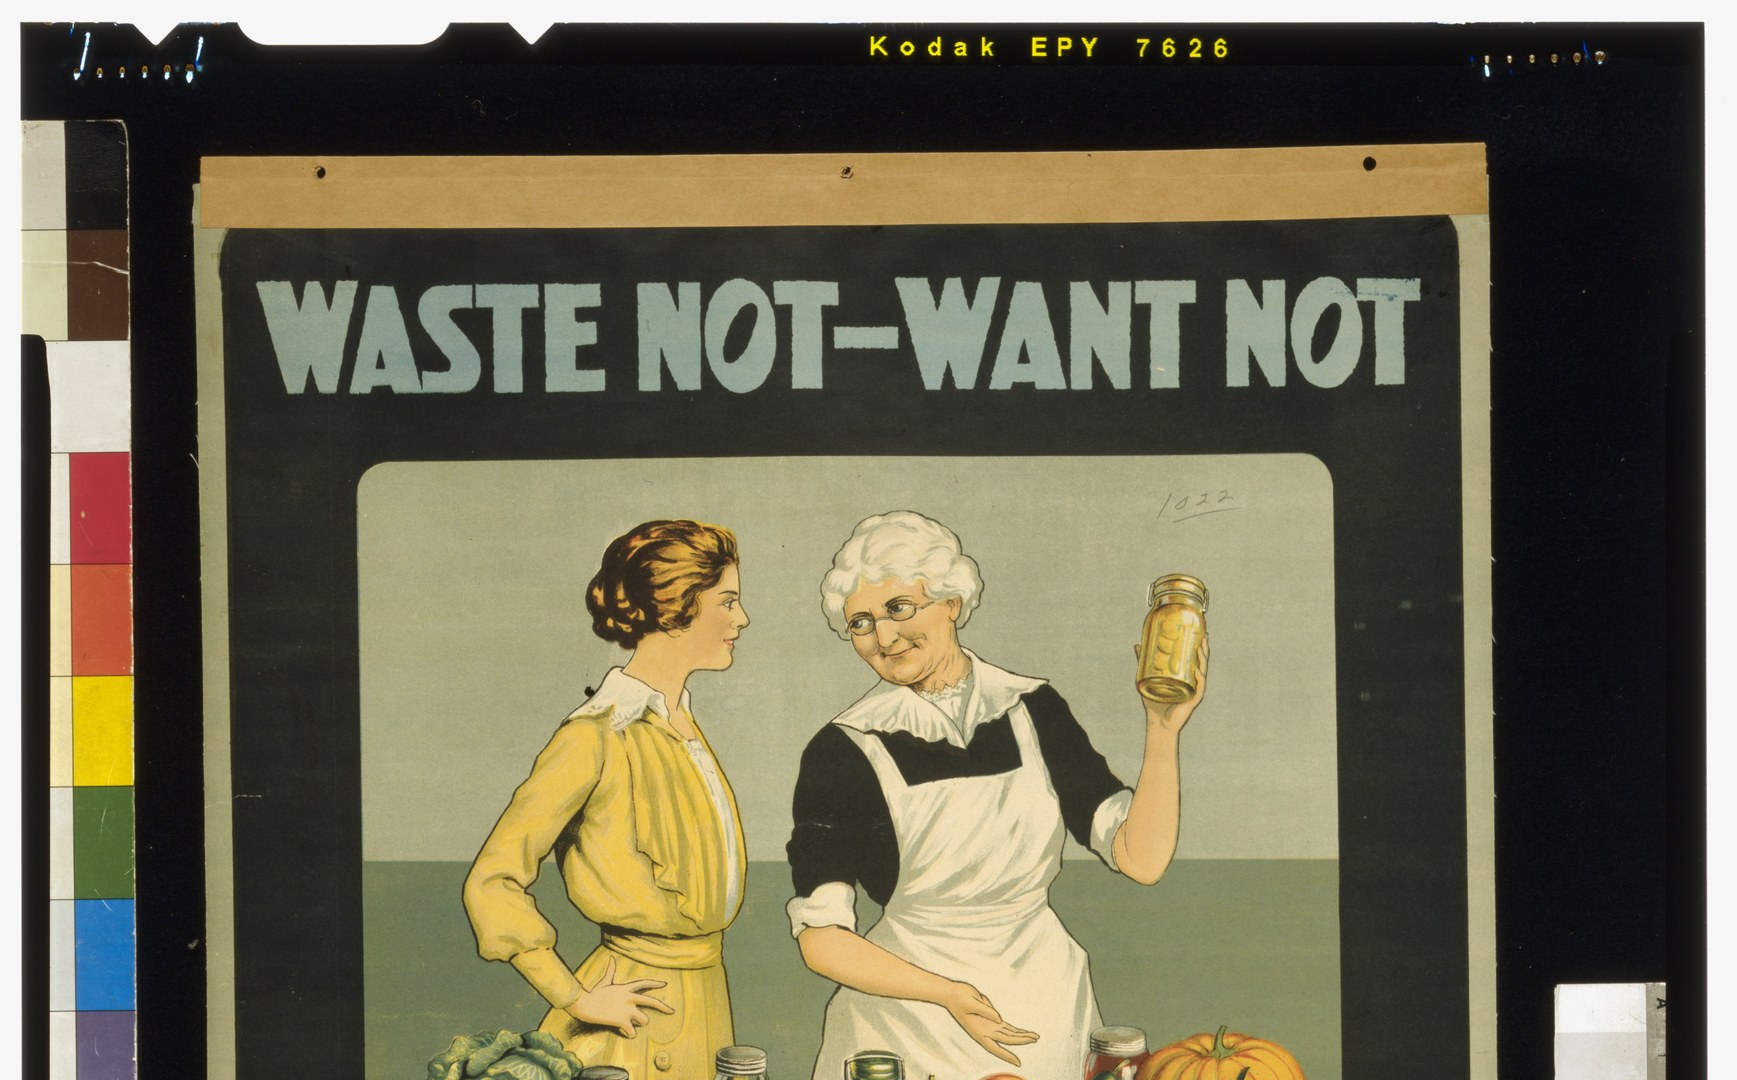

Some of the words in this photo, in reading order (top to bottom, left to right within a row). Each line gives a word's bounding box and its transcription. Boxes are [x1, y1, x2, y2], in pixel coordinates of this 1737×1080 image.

[869, 35, 994, 57] Kodak
[1031, 36, 1098, 57] EPY
[1136, 37, 1228, 58] 7626
[256, 280, 606, 395] WASTE
[1225, 277, 1421, 389] NOT
